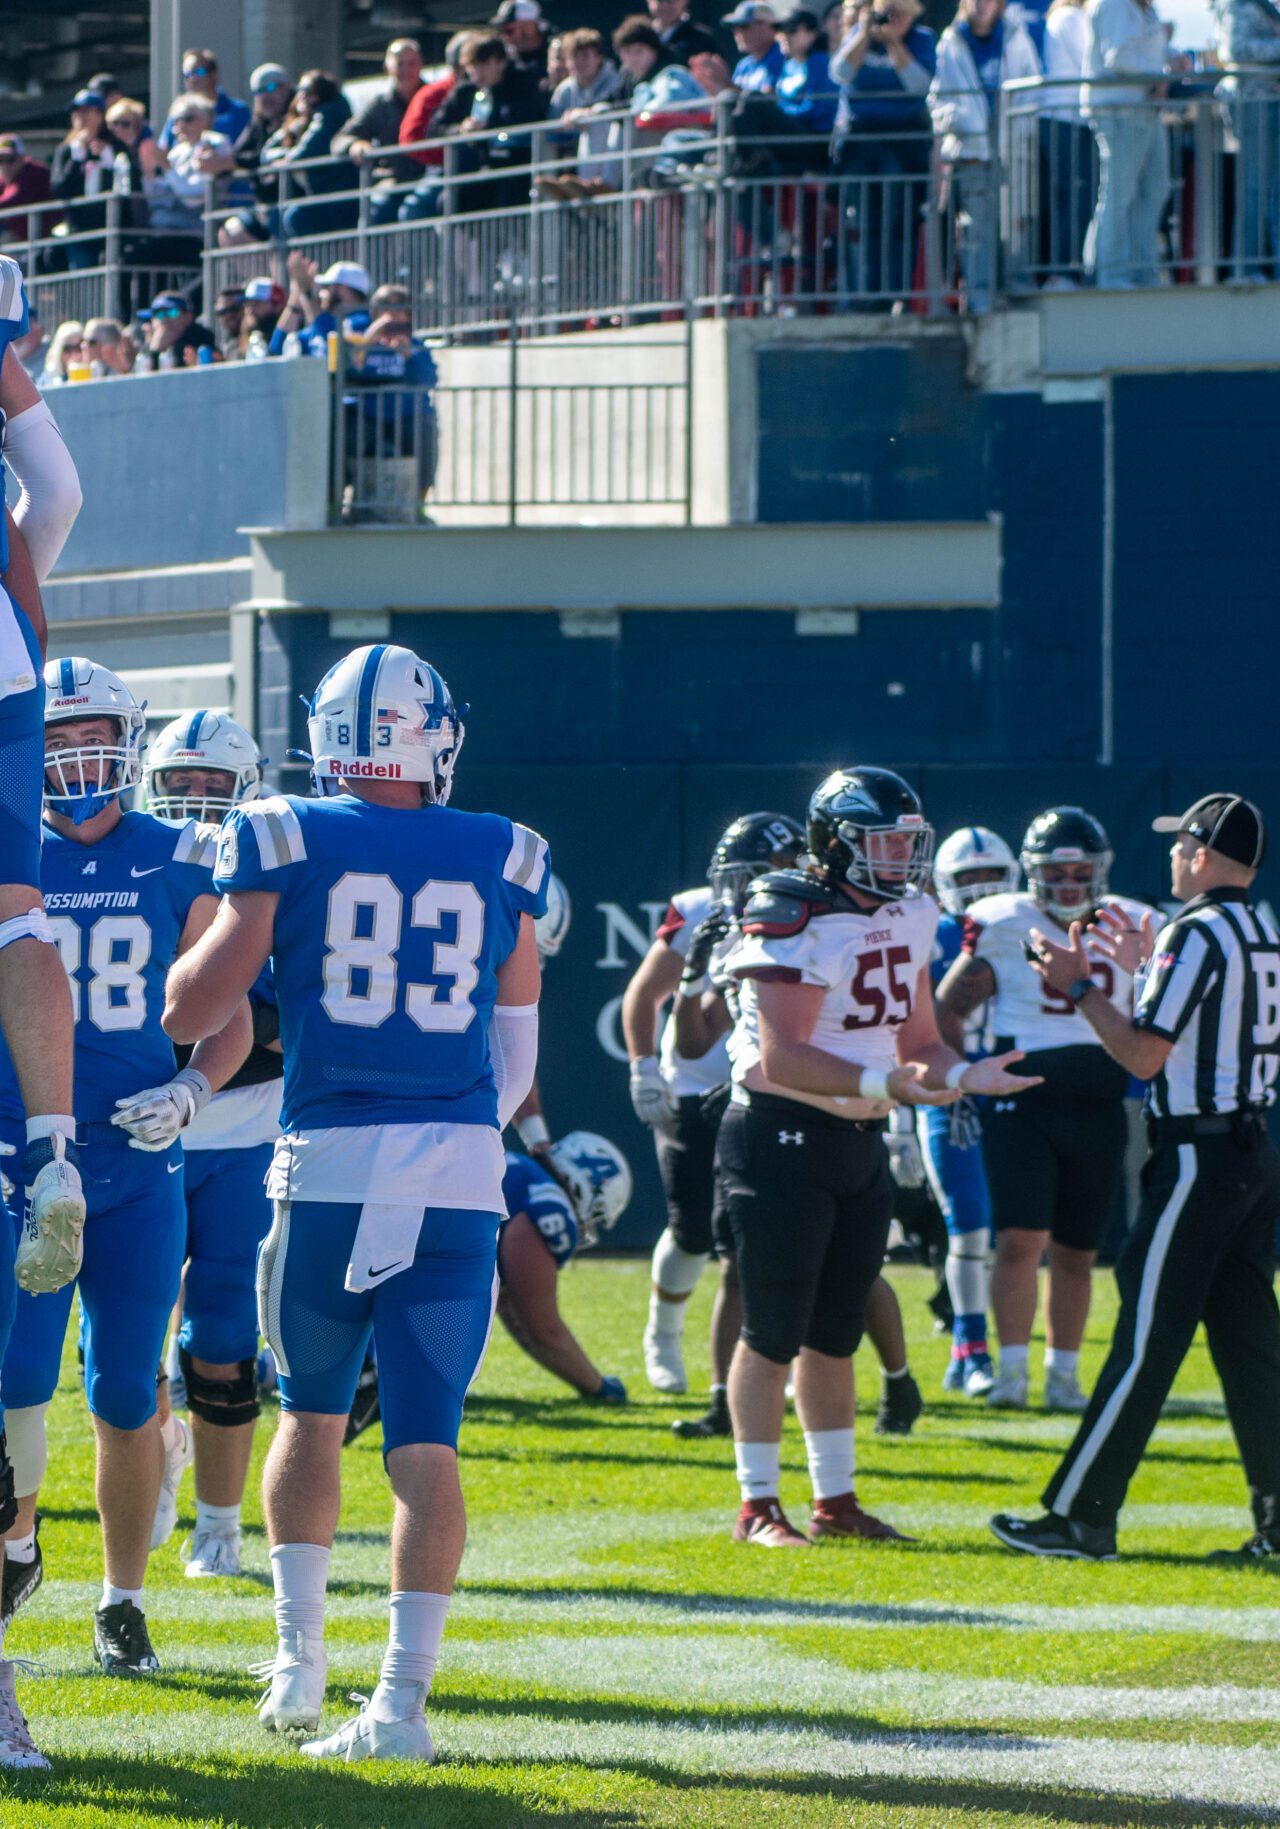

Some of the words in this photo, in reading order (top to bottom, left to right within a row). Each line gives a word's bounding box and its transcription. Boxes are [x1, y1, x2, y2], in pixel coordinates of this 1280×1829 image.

[53, 696, 89, 707] Riddell
[329, 759, 401, 778] Riddell
[763, 821, 795, 851] 19
[44, 891, 139, 909] ASSUMPTION
[320, 871, 486, 1033] 83
[841, 945, 912, 1031] 55
